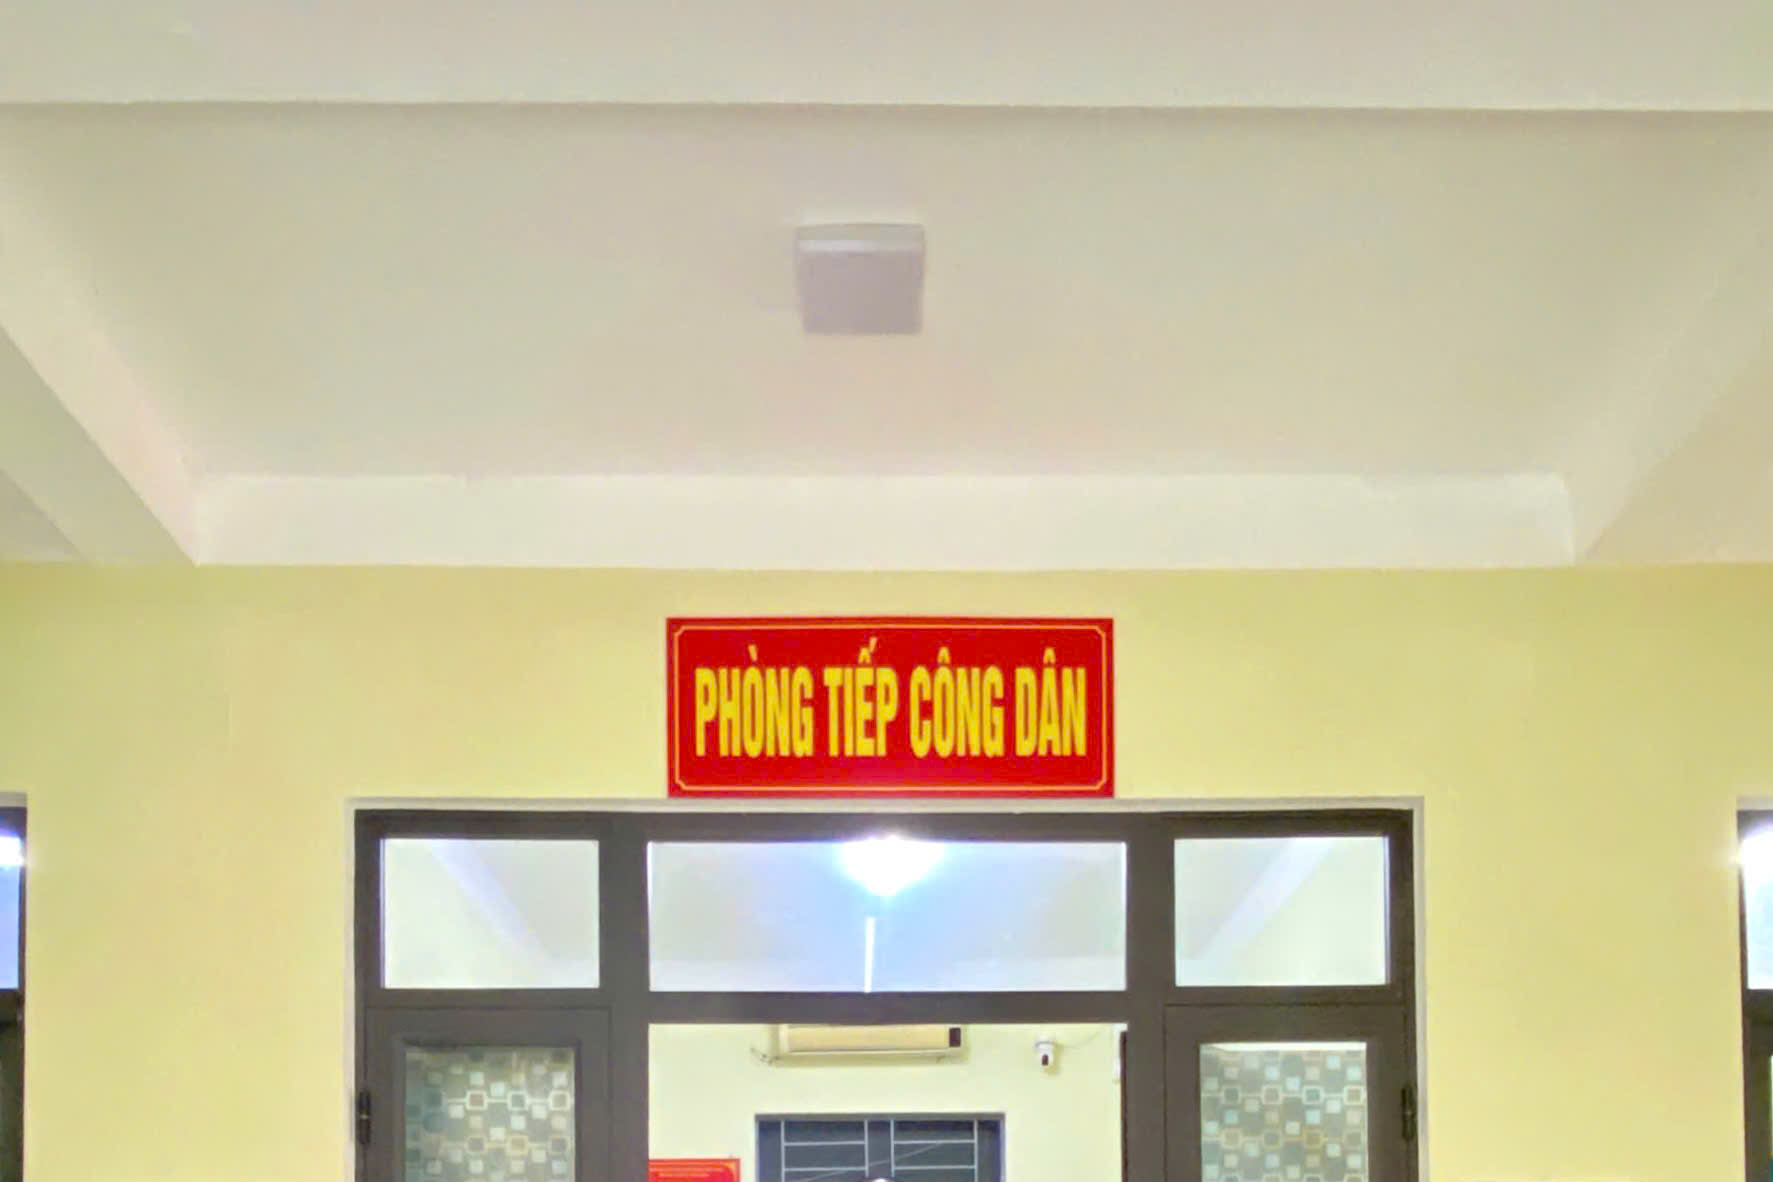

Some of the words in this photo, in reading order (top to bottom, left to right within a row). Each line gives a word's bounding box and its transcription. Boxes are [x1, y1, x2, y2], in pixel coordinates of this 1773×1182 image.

[694, 644, 815, 758] PHÒNG
[823, 636, 898, 758] TIẾP
[909, 646, 1005, 759] CÔNG
[1015, 646, 1087, 758] DÂN
